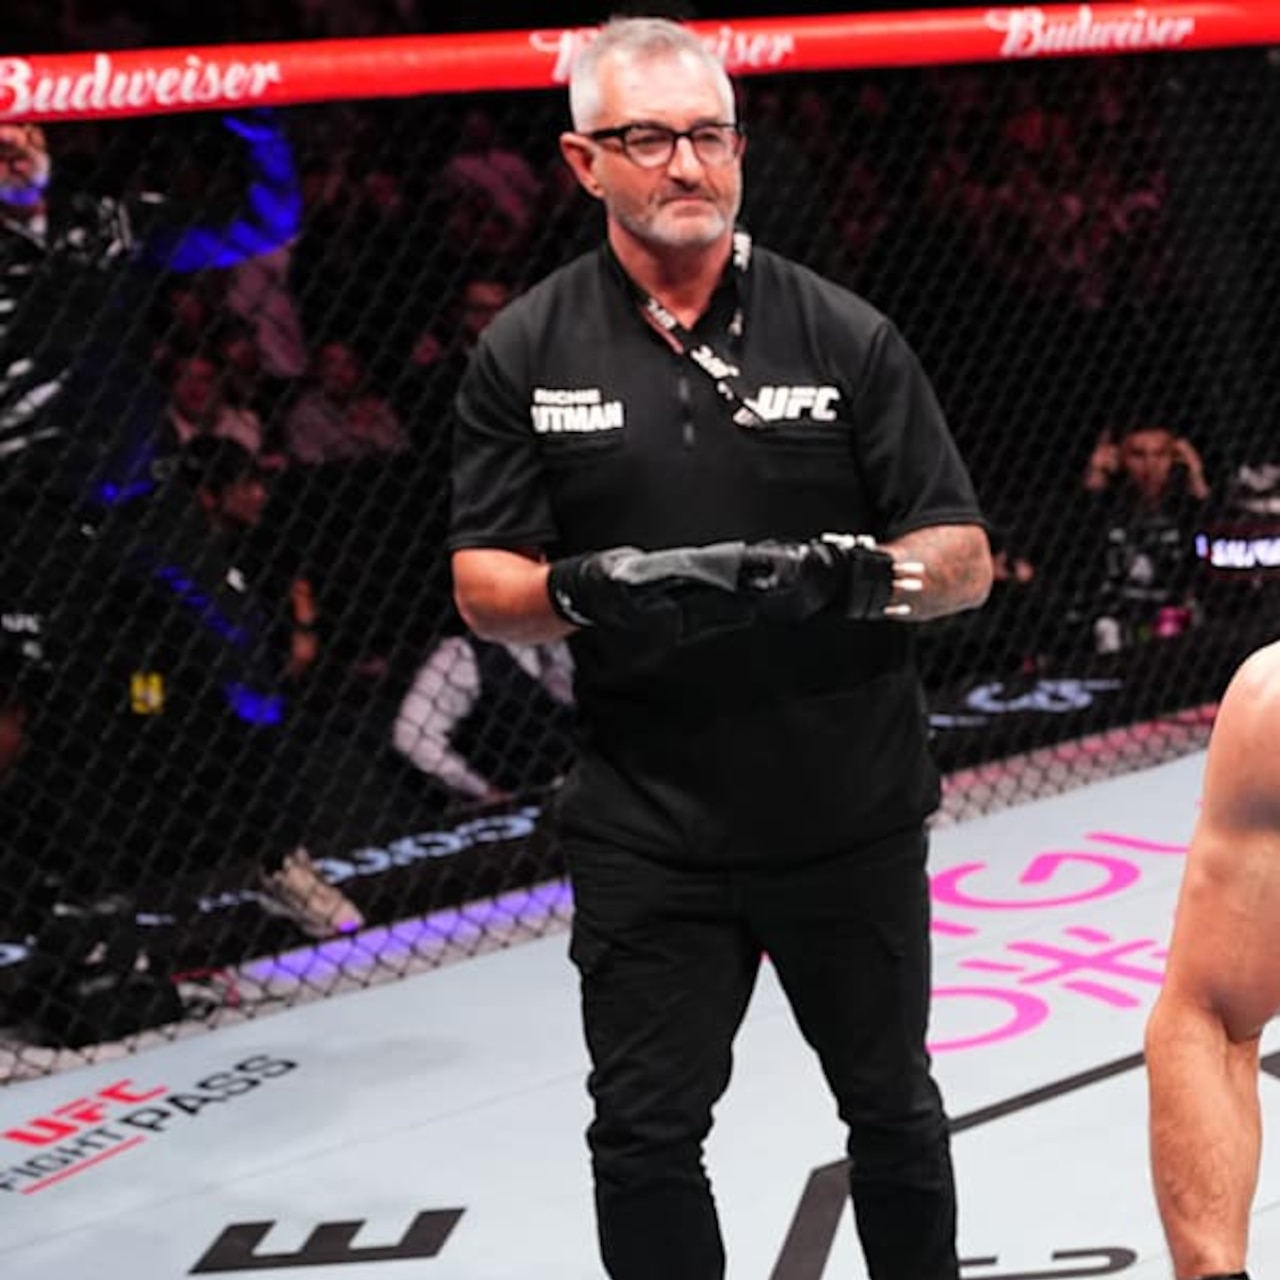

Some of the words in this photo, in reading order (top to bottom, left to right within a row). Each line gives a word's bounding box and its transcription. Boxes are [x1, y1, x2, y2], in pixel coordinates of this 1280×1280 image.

[529, 25, 795, 83] Beiser
[984, 5, 1194, 57] Budweiser
[756, 385, 841, 422] UFC
[1, 1077, 170, 1146] UFC
[117, 1054, 299, 1134] PASS
